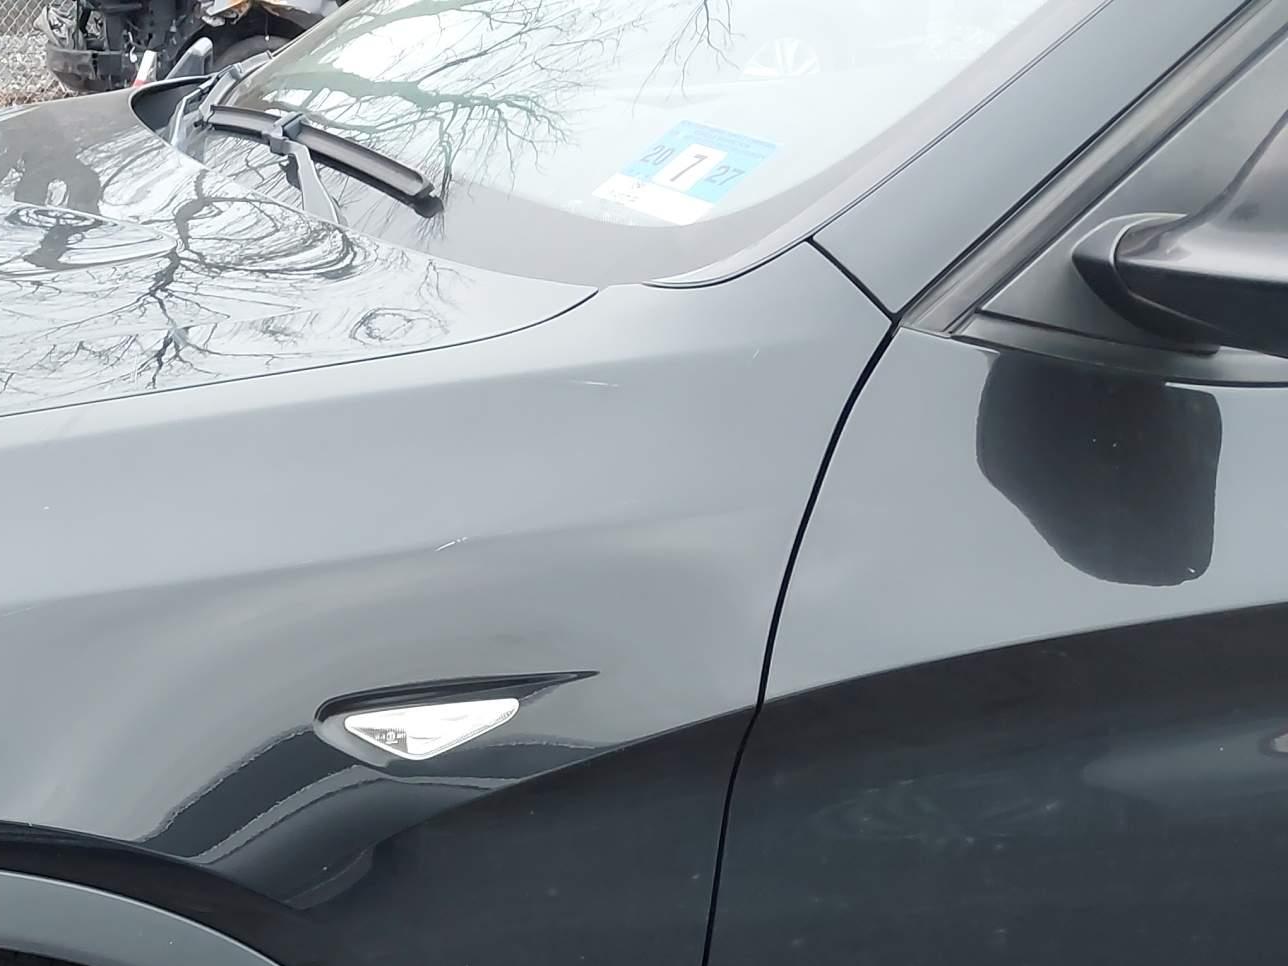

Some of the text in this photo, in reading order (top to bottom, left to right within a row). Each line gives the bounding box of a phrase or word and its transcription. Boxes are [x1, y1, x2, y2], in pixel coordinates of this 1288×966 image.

[640, 144, 676, 166] 20
[669, 153, 708, 182] 7
[704, 165, 746, 187] 27
